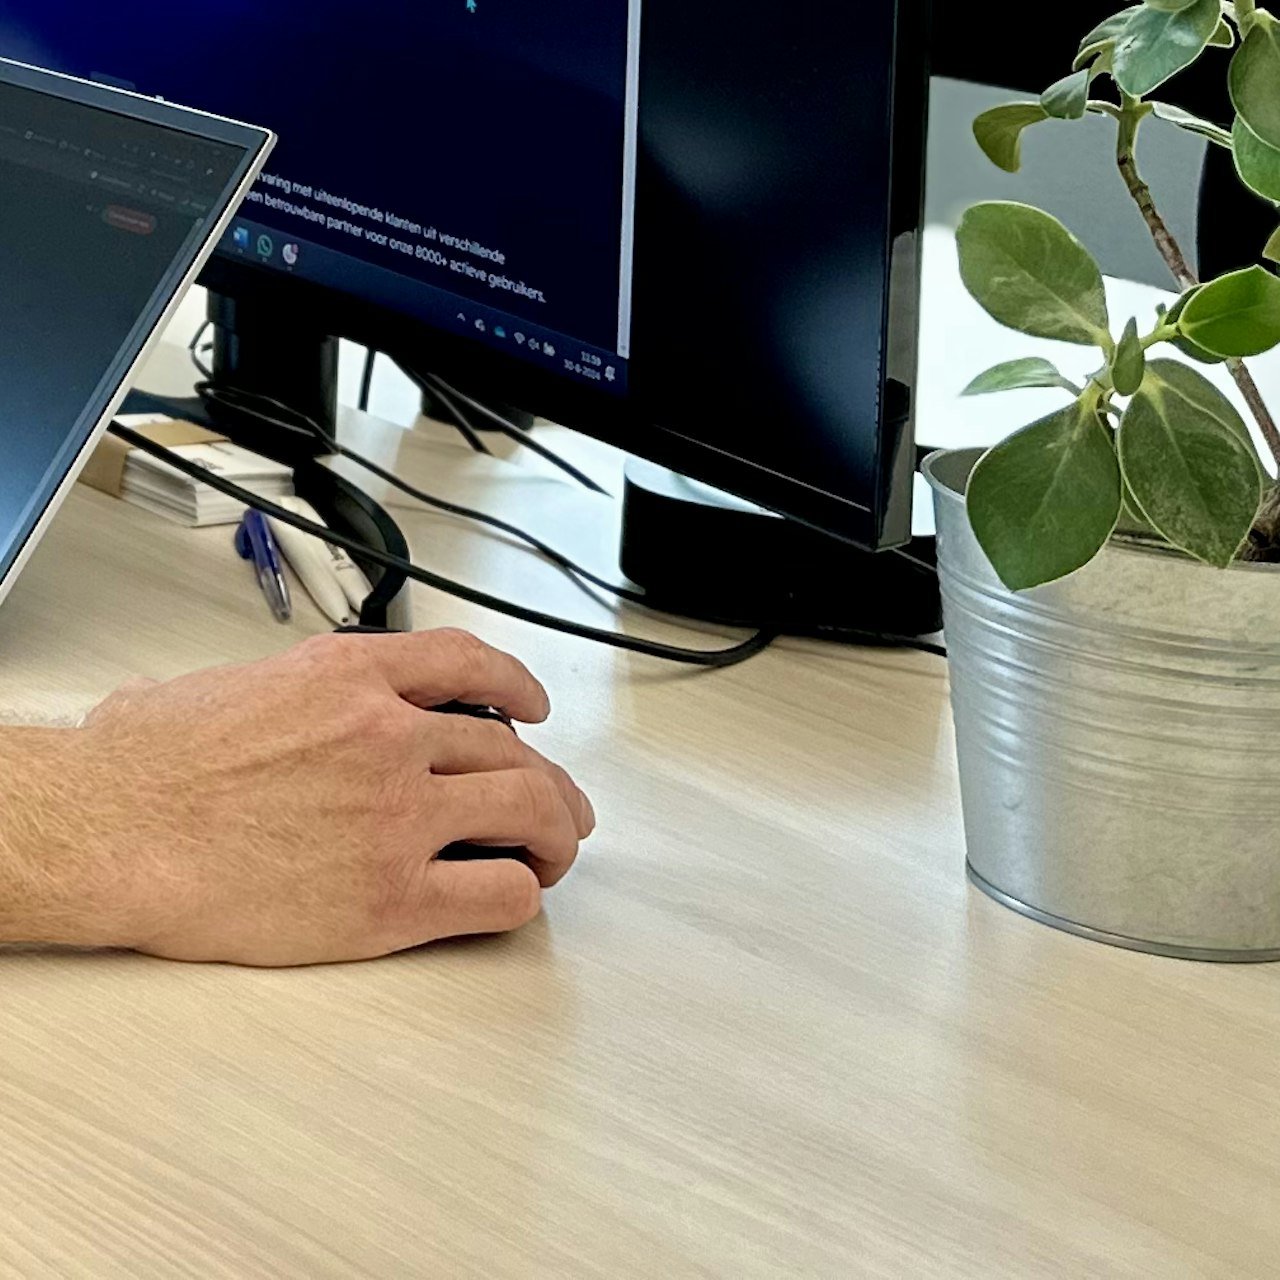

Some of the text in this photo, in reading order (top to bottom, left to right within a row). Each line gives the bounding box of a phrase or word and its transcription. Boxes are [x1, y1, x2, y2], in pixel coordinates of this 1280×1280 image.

[264, 192, 326, 225] betrouwbare
[326, 216, 364, 238] partner
[364, 228, 389, 246] voor
[389, 238, 414, 256] onze
[415, 244, 448, 266] 8000+
[449, 258, 487, 282] actieve
[487, 273, 547, 303] gebruikers.
[292, 181, 313, 198] met
[313, 188, 383, 222] uiteenlopende
[385, 211, 421, 235] klanten
[423, 225, 437, 241] uit
[438, 231, 506, 265] verschillende
